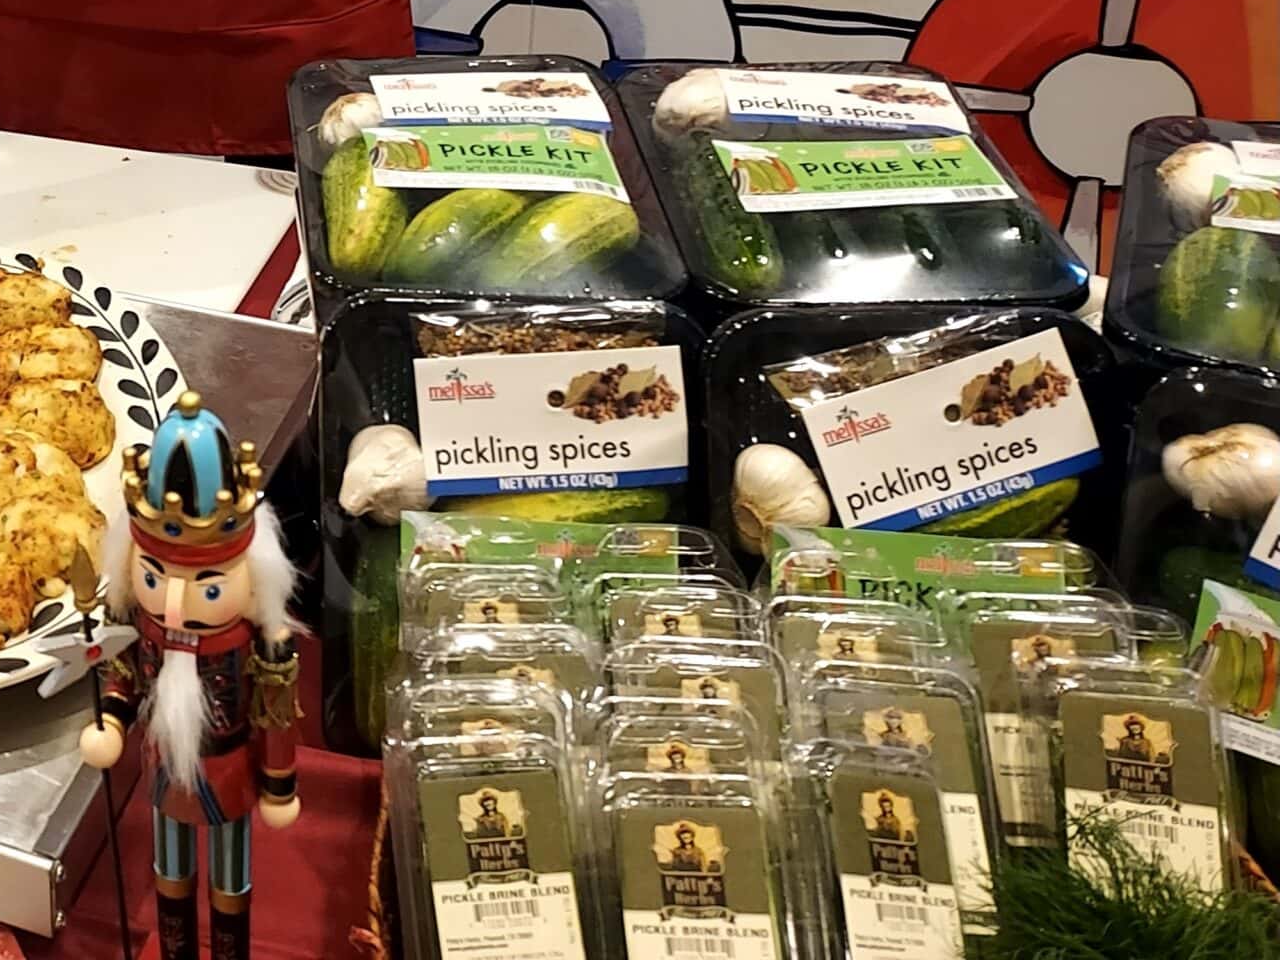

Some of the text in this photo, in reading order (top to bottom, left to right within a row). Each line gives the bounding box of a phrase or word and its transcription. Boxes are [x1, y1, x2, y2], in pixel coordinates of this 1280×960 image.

[391, 102, 559, 116] pickling spices
[738, 96, 915, 122] pickling spices
[437, 143, 537, 159] PICKLE
[544, 145, 593, 164] KIT
[799, 157, 963, 177] PICKLE KIT
[434, 434, 632, 474] pickling spices
[498, 475, 523, 490] NET
[550, 473, 569, 488] 1.5
[569, 472, 589, 488] OZ
[845, 436, 1039, 520] pickling spices
[916, 502, 943, 520] NET
[968, 490, 987, 505] 1.5
[985, 483, 1006, 499] OZ
[858, 580, 934, 611] PICK
[1110, 762, 1169, 783] Patty's
[1171, 816, 1215, 830] BLEND
[471, 840, 525, 859] Patty's
[664, 875, 723, 893] Patty's
[849, 887, 884, 900] PICKLE
[441, 884, 570, 905] PICKLE BRINE BLEND
[631, 924, 769, 939] PICKLE BRINE BLEND
